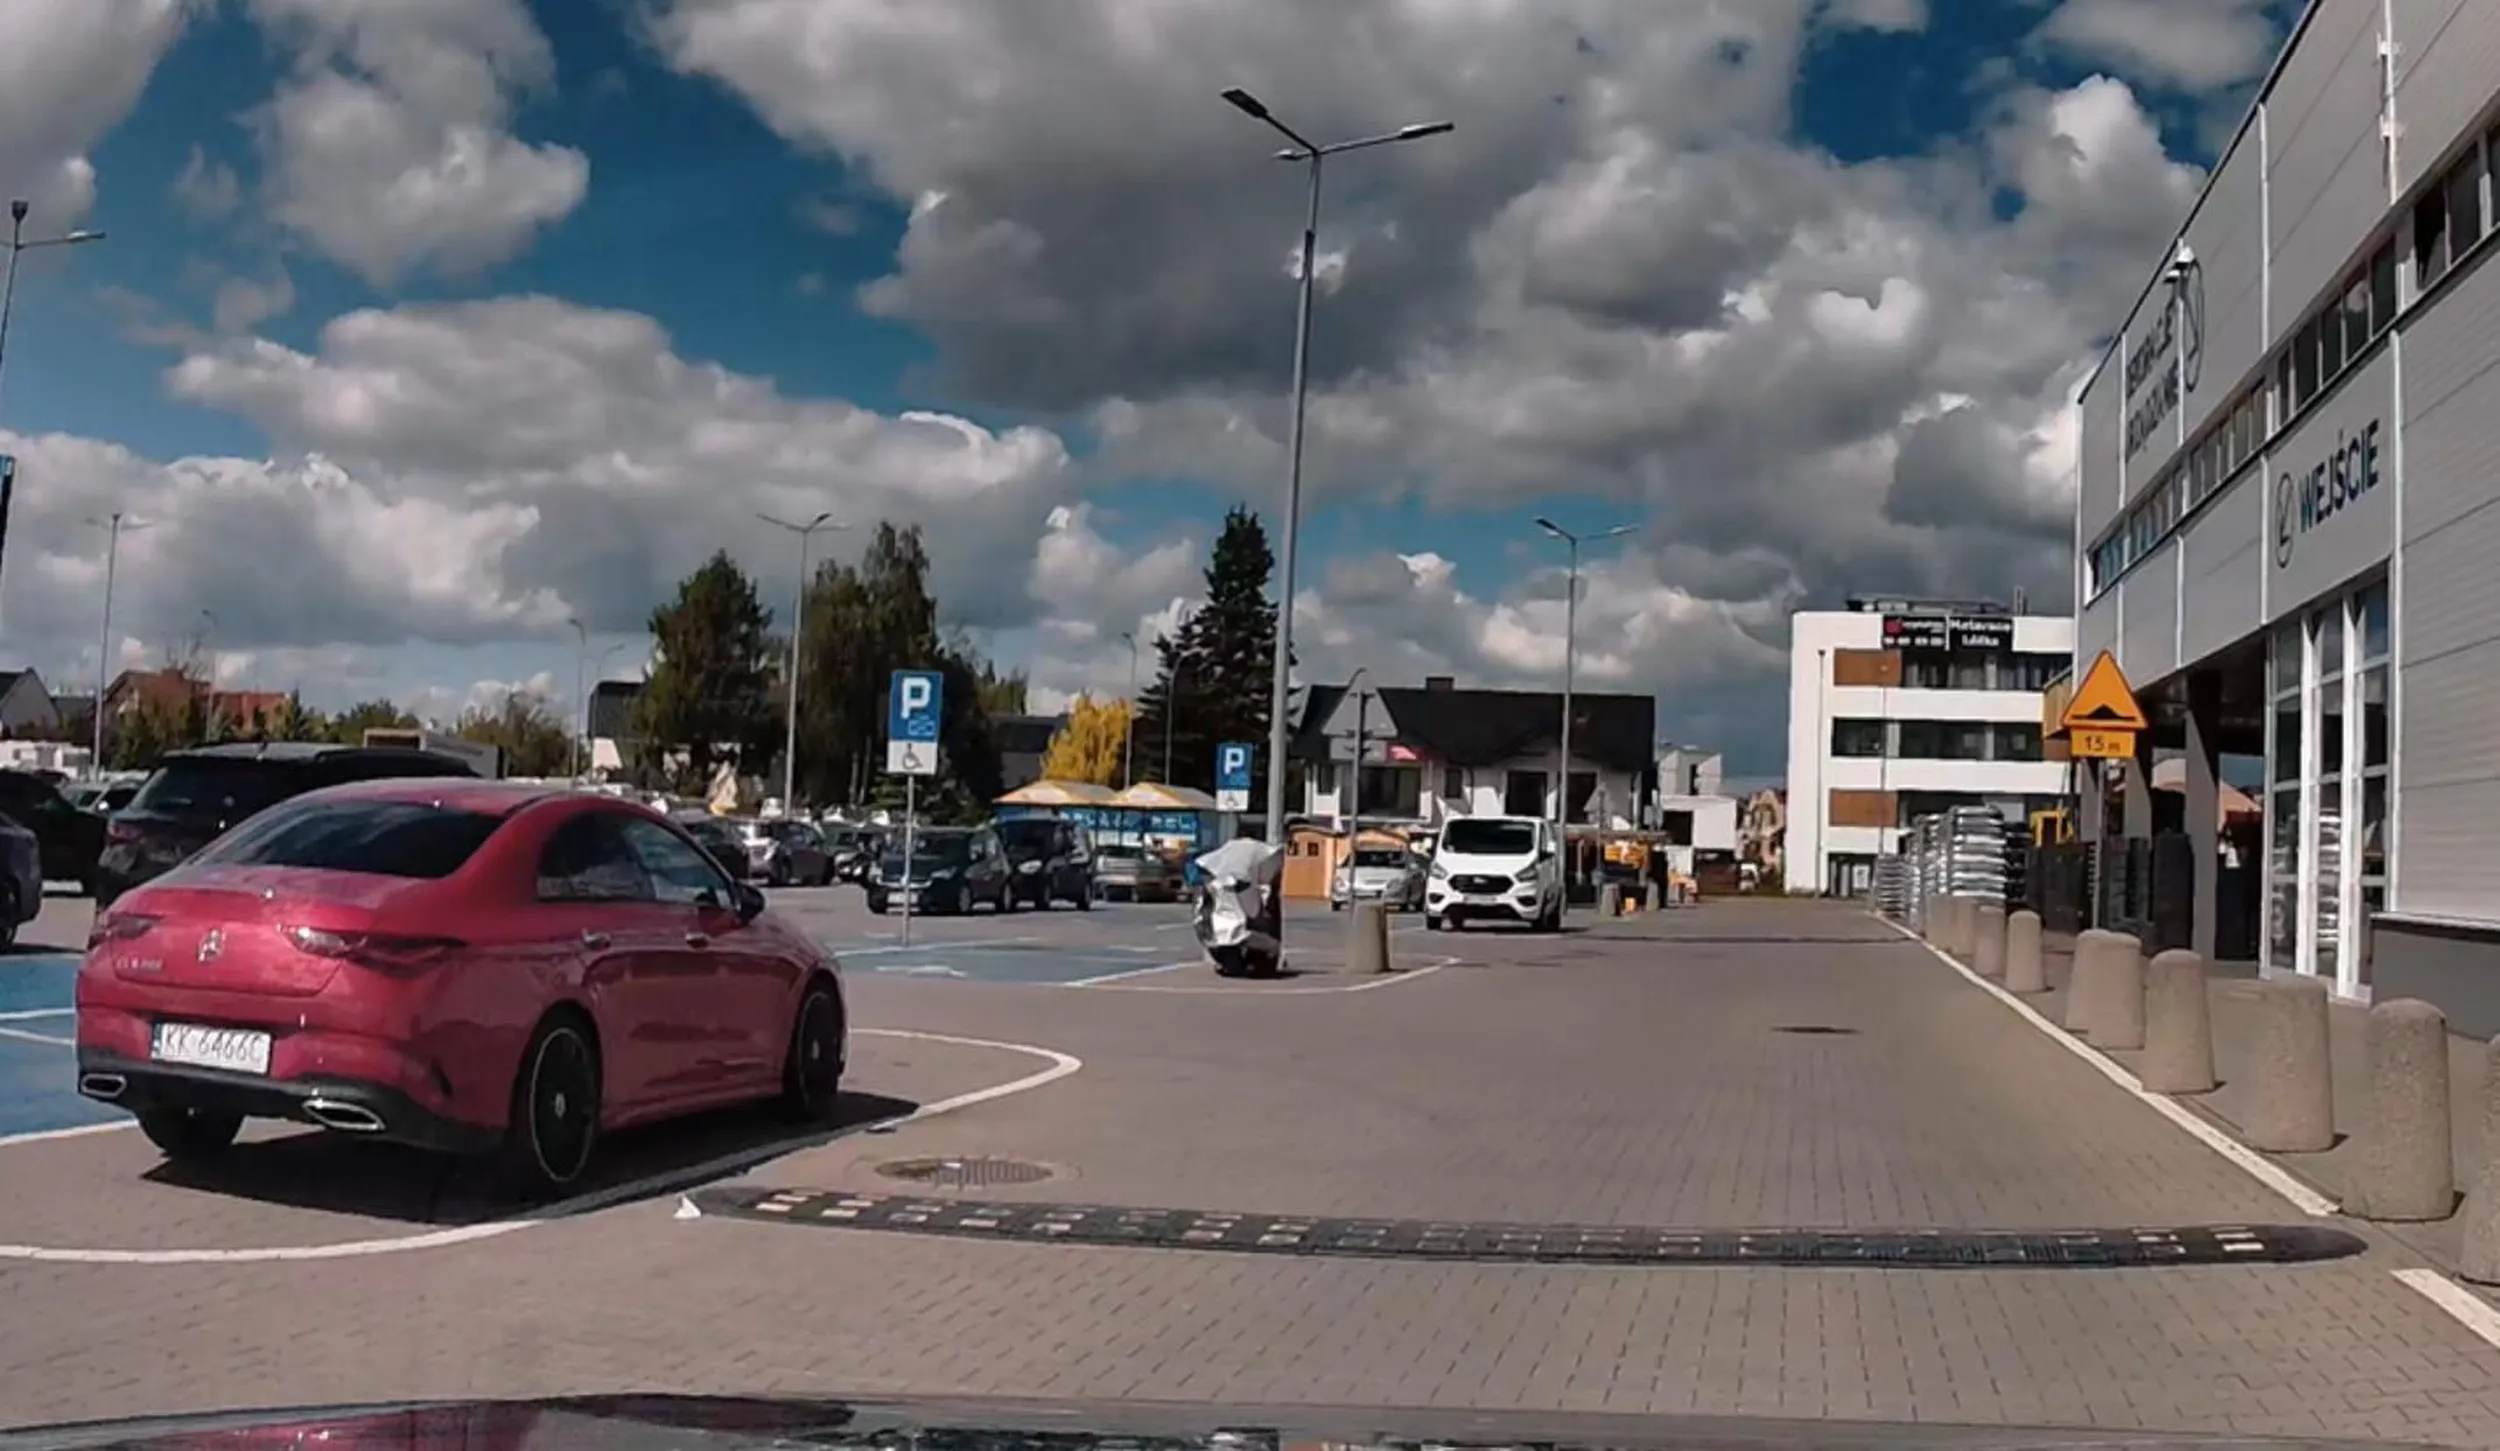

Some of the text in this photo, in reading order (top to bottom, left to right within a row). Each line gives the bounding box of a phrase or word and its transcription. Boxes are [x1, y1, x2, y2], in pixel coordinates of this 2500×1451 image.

[2297, 418, 2380, 534] WEJŚCIE
[900, 676, 932, 720] P
[1223, 747, 1246, 775] P
[166, 1024, 263, 1063] KK 6466C
